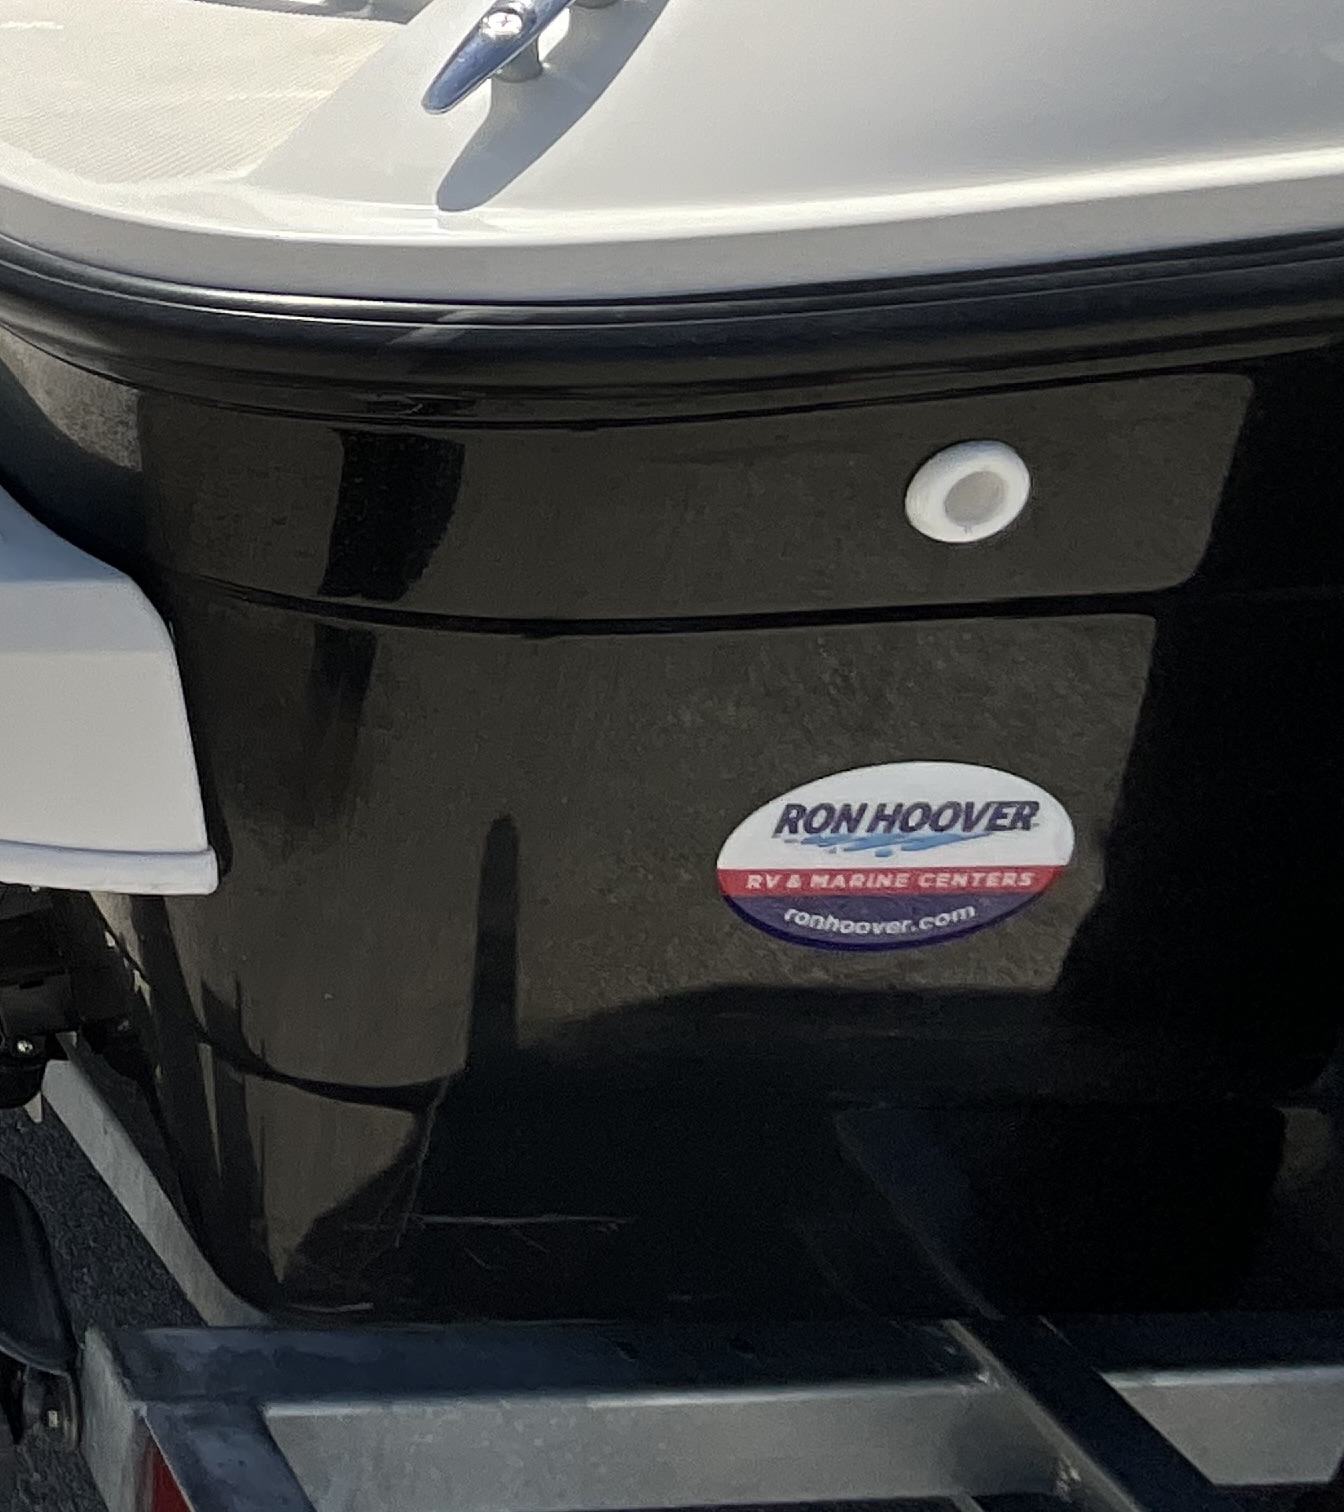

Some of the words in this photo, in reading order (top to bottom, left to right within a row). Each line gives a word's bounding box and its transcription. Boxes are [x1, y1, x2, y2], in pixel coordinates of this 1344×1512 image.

[773, 802, 868, 835] RON
[866, 800, 1041, 833] HOOVER
[745, 875, 780, 890] RV
[786, 874, 803, 889] &
[810, 873, 912, 889] MARINE
[918, 871, 1036, 888] CENTERS
[783, 904, 977, 935] ronhoover.com
